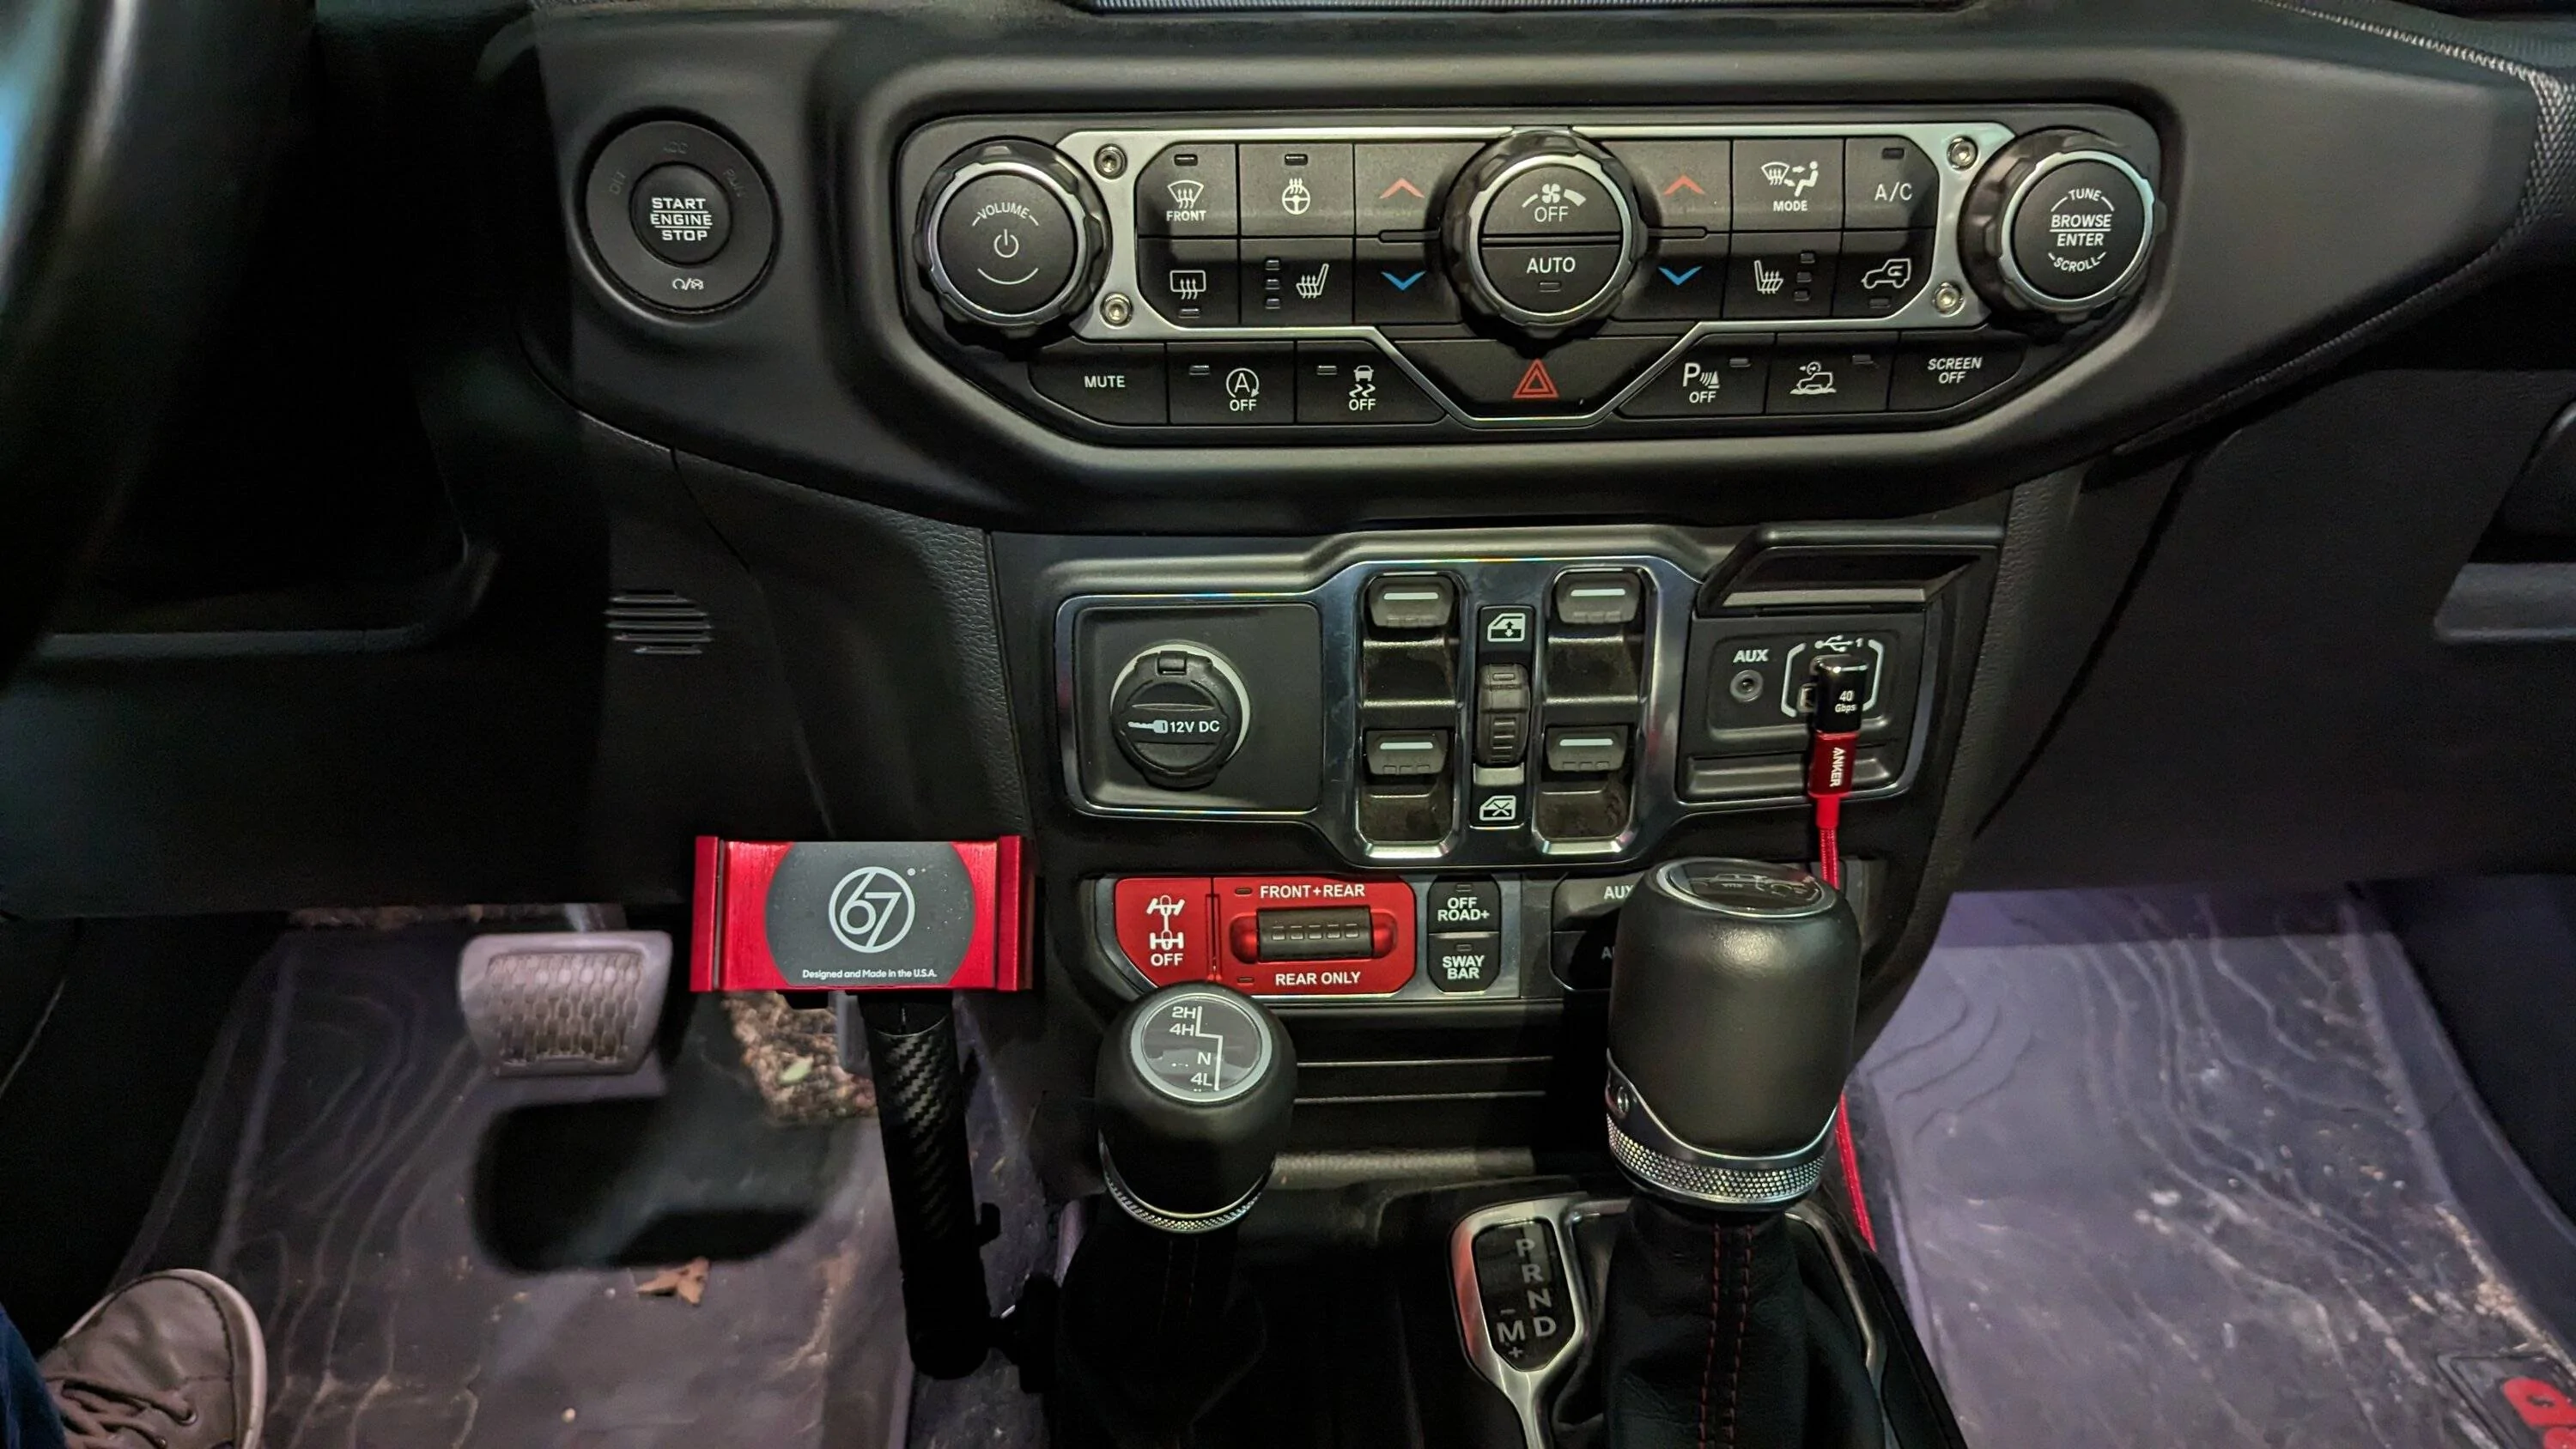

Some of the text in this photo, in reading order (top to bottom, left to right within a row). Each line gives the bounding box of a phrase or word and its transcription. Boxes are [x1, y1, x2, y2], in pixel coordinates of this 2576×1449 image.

[1874, 181, 1913, 203] A/C
[2068, 188, 2102, 202] TUNE
[652, 197, 707, 209] START
[1773, 200, 1807, 212] MODE
[977, 202, 1030, 220] VOLUME
[1166, 209, 1206, 221] FRONT
[1534, 206, 1569, 222] OFF
[650, 214, 713, 226] ENGINE
[2050, 214, 2112, 228] BROWSE
[662, 229, 708, 241] STOP
[2057, 233, 2104, 247] ENTER
[1526, 257, 1576, 274] AUTO
[2053, 257, 2101, 272] SCROLL
[1927, 357, 1983, 371] SCREEN
[1084, 375, 1126, 389] MUTE
[1682, 363, 1701, 388] P
[1938, 371, 1965, 385] OFF
[1689, 391, 1716, 404] OFF
[1229, 399, 1257, 412] OFF
[1348, 398, 1376, 412] OFF
[1733, 649, 1769, 663] AUX
[1839, 690, 1855, 702] 40
[1834, 703, 1857, 713] Gbps
[1170, 721, 1220, 733] 12V DC
[1829, 747, 1846, 788] ANKER
[1604, 885, 1634, 900] AUX
[1447, 897, 1477, 909] OFF
[1437, 909, 1490, 921] ROAD+
[1151, 954, 1183, 967] OFF
[1442, 955, 1485, 968] SWAY
[803, 969, 938, 979] Designed and Made in the U.S.A.
[1275, 972, 1361, 985] REAR ONLY
[1447, 967, 1479, 980] BAR
[1171, 1006, 1196, 1019] 2H
[1169, 1023, 1194, 1036] 4H
[1197, 1052, 1212, 1065] N
[1190, 1072, 1212, 1087] 4L
[1516, 1239, 1535, 1257] P
[1522, 1264, 1544, 1283] R
[1527, 1288, 1552, 1309] N
[1497, 1319, 1526, 1343] M
[1533, 1316, 1557, 1337] D
